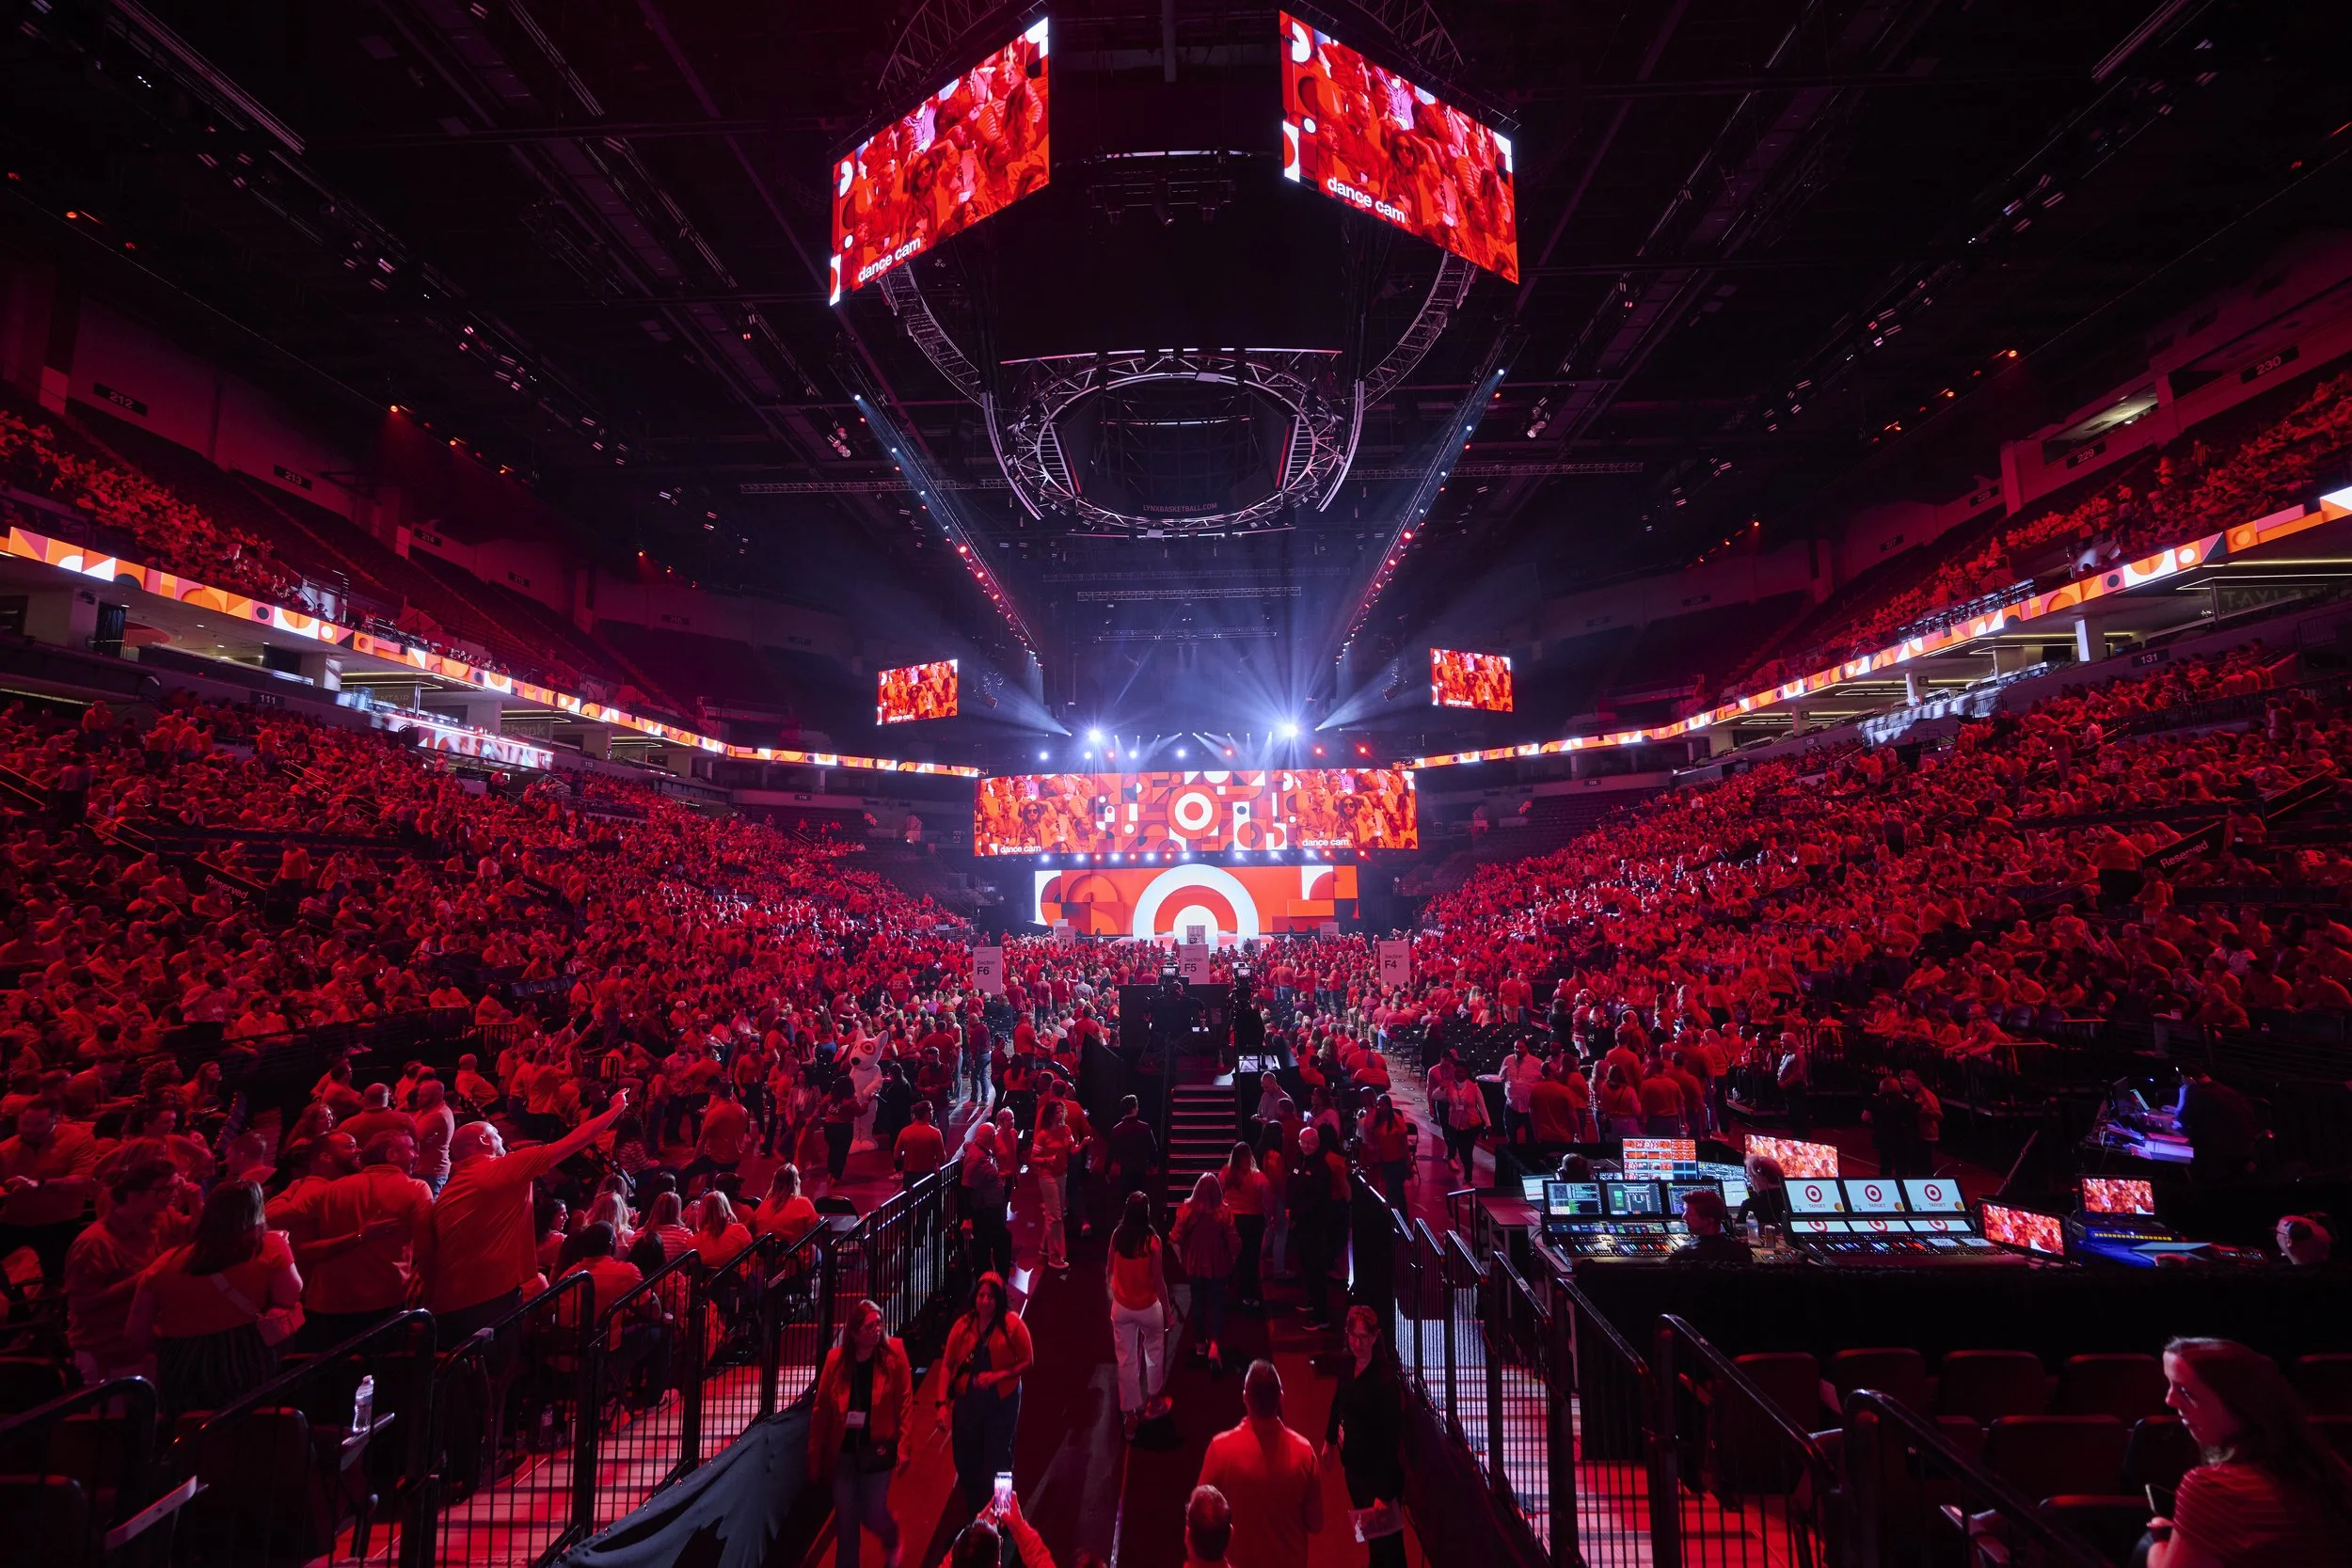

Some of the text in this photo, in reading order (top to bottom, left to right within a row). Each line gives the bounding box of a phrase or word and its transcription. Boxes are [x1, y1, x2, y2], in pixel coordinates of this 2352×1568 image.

[1327, 177, 1405, 223] dance cam
[858, 237, 920, 282] dance cam
[2257, 356, 2281, 375] 230
[109, 391, 133, 409] 212
[2077, 449, 2093, 463] 229
[1143, 502, 1217, 513] LYNXBASKETBALL.COM
[2141, 653, 2157, 664] 131
[260, 694, 276, 705] 111
[375, 692, 409, 702] ENTAIR
[205, 874, 248, 899] Reserved
[523, 883, 549, 897] eserved
[977, 966, 990, 975] F6
[1184, 963, 1197, 973] F5
[1385, 960, 1397, 969] F4
